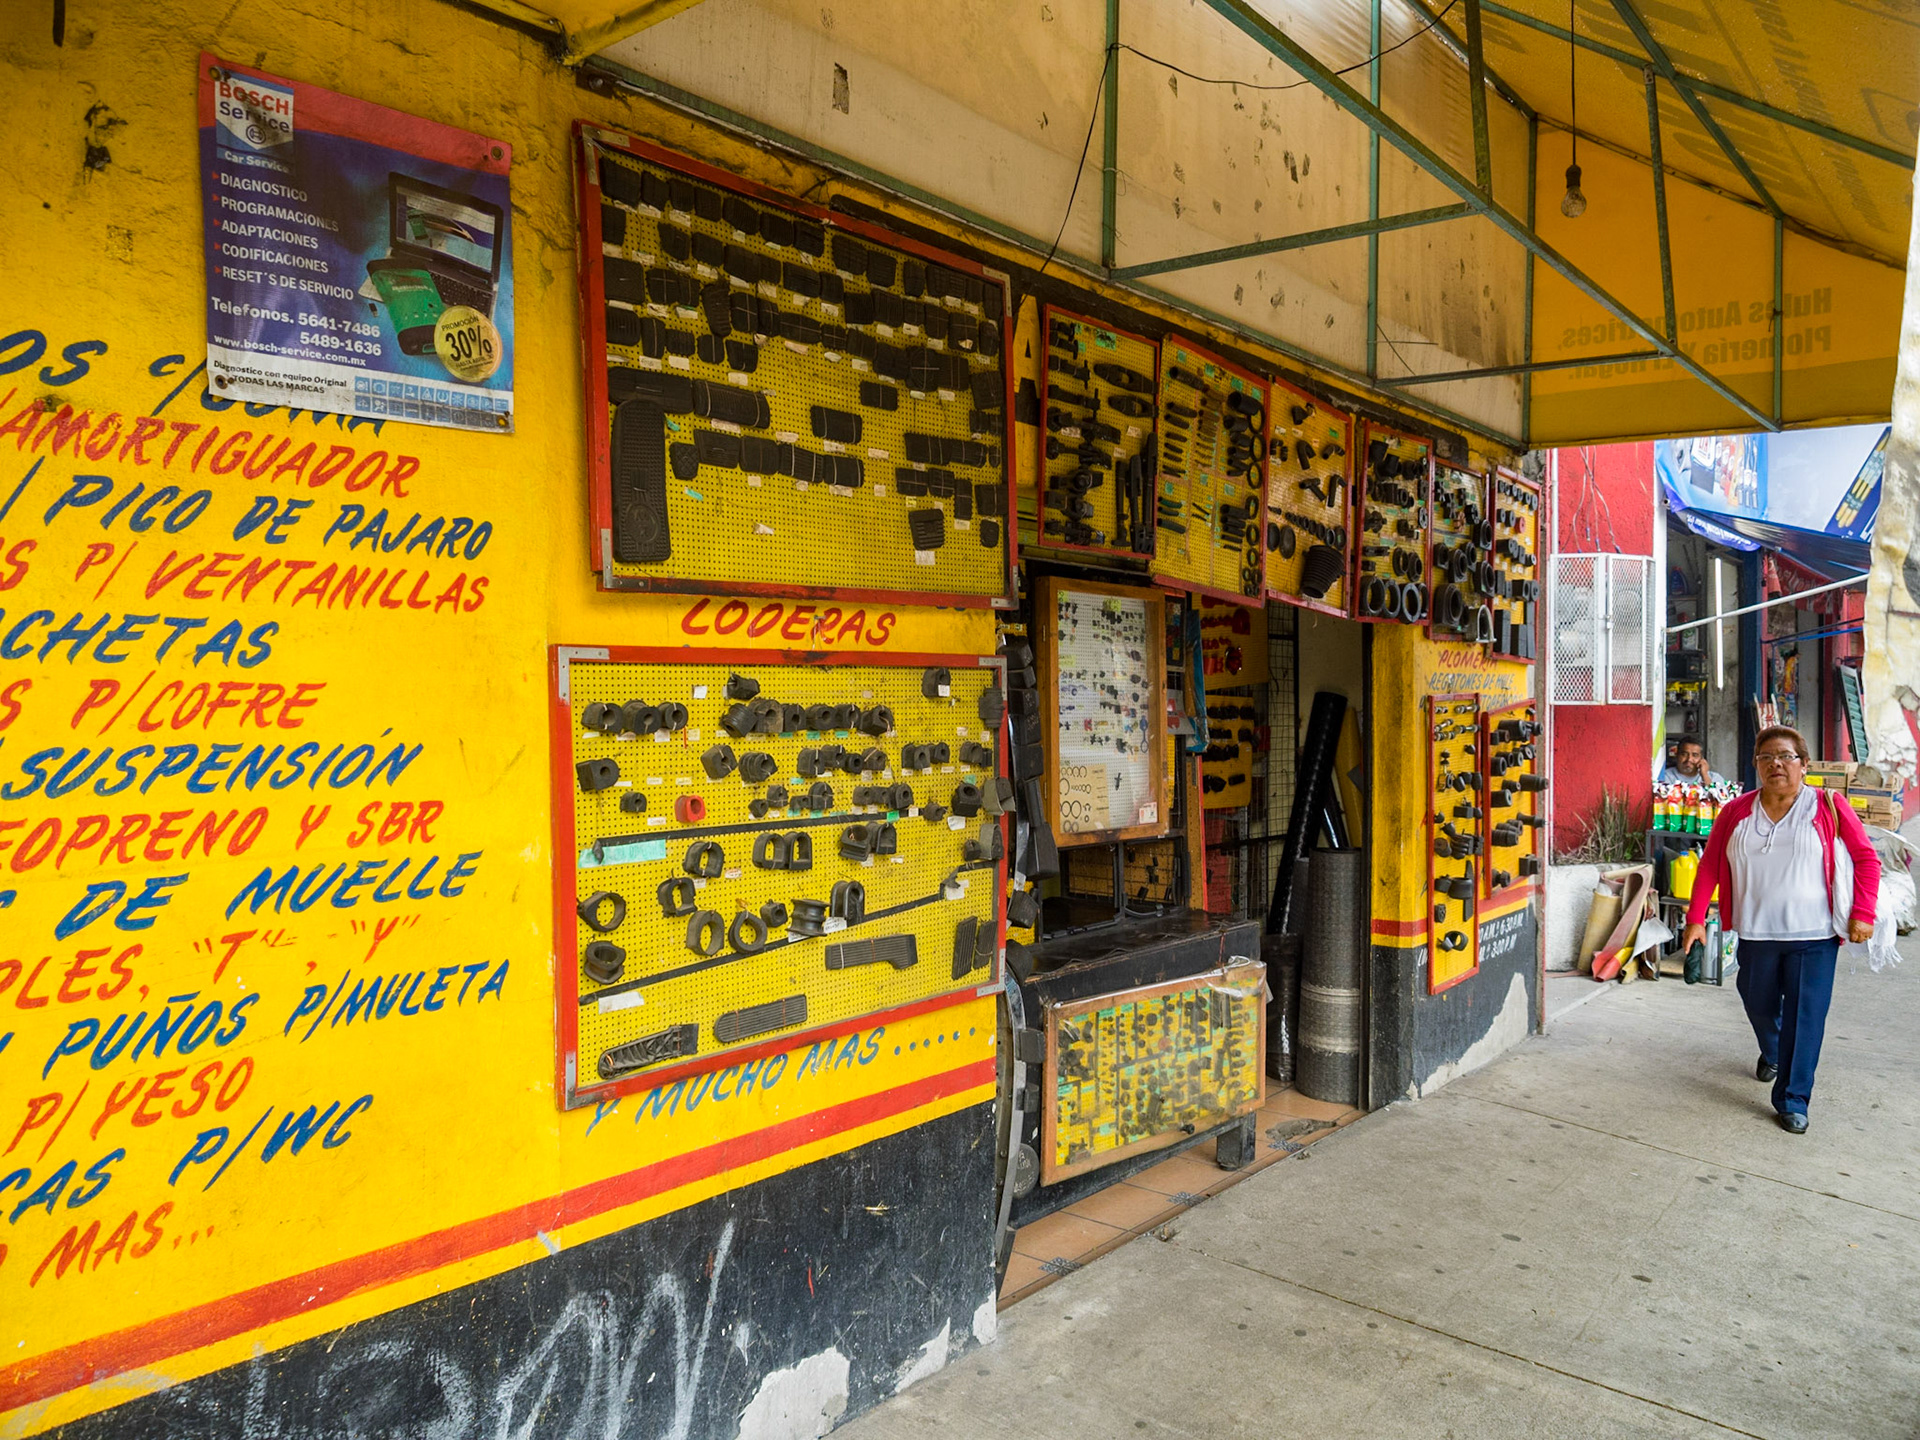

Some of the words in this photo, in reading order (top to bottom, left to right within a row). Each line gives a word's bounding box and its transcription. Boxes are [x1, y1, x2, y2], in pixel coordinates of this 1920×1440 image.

[219, 81, 290, 116] BOSCH
[219, 101, 291, 133] Service
[224, 150, 245, 164] Car
[246, 155, 291, 174] Service
[221, 172, 308, 203] DIAGNOSTICO
[221, 196, 340, 233] PROGRAMACIONES
[221, 219, 319, 250] ADAPTACIONES
[222, 242, 329, 274] CODIFICACIONES
[279, 275, 297, 290] DE
[299, 280, 354, 301] SERVICIO
[212, 296, 295, 325] Telefonos.
[298, 312, 381, 338] 5641-7486
[213, 333, 367, 367] www.bosch-service.com.mx
[300, 331, 382, 357] 5489-1636
[445, 325, 493, 362] 30%
[213, 360, 263, 376] Diagnostico
[264, 369, 281, 379] con
[282, 373, 313, 384] equipo
[314, 376, 347, 387] Original
[266, 379, 285, 389] LAS
[286, 381, 326, 394] MARCAS
[43, 474, 214, 535] PICO
[232, 495, 316, 545] DE
[323, 503, 493, 561] PAJARO
[0, 536, 38, 592] S
[0, 607, 280, 668] CHETAS
[295, 804, 330, 850] Y
[347, 799, 444, 848] SBR
[54, 872, 191, 941] DE
[225, 849, 485, 922] MUELLE
[42, 989, 261, 1081] PUÑOS
[90, 1056, 255, 1142] YESO
[634, 1053, 789, 1126] MUCHO
